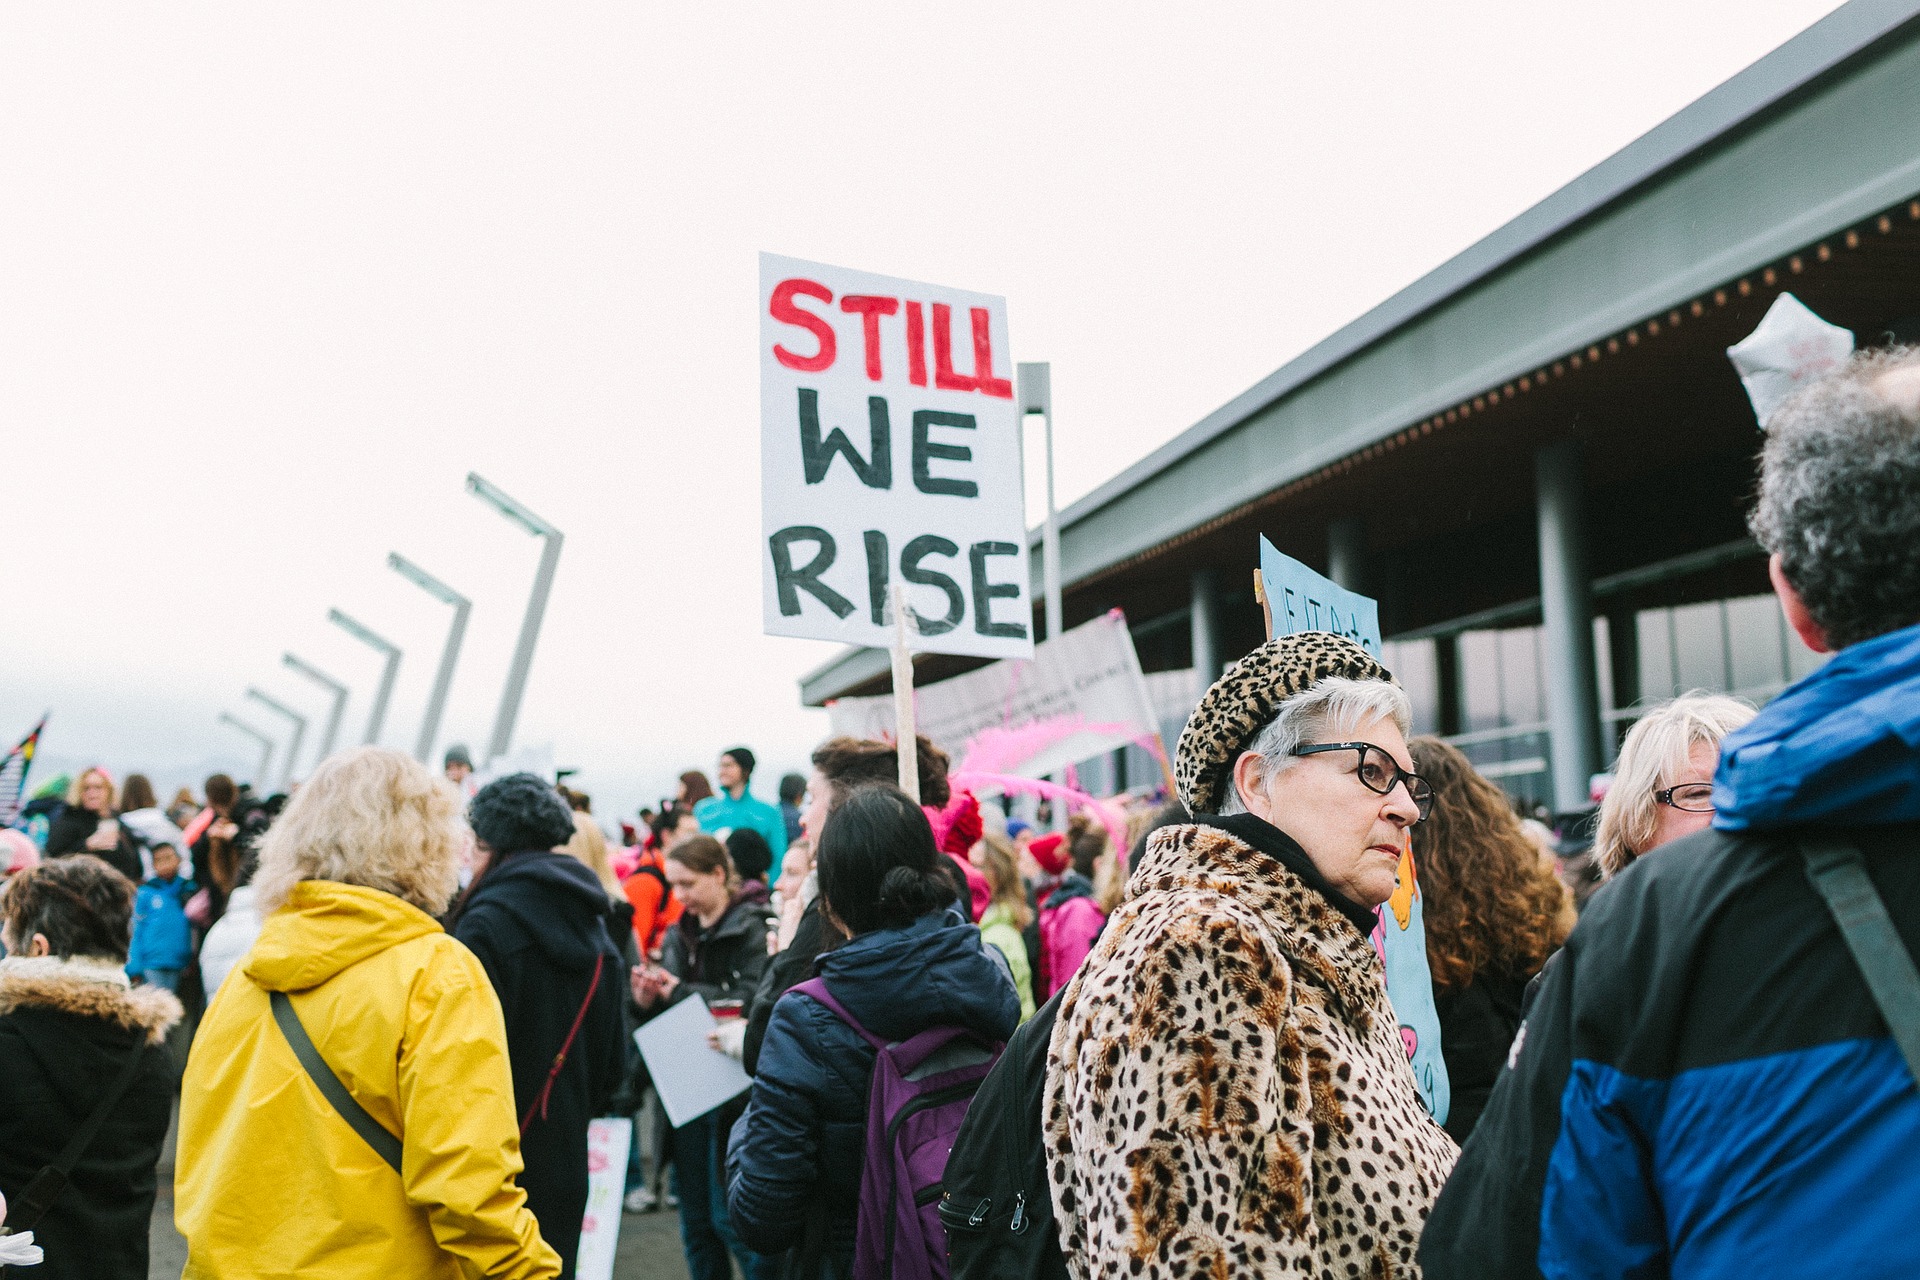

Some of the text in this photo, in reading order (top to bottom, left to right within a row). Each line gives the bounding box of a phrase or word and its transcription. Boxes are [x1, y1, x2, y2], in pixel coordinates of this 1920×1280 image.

[768, 277, 1013, 401] STILL
[797, 387, 979, 499] WE
[768, 525, 1029, 641] RISE
